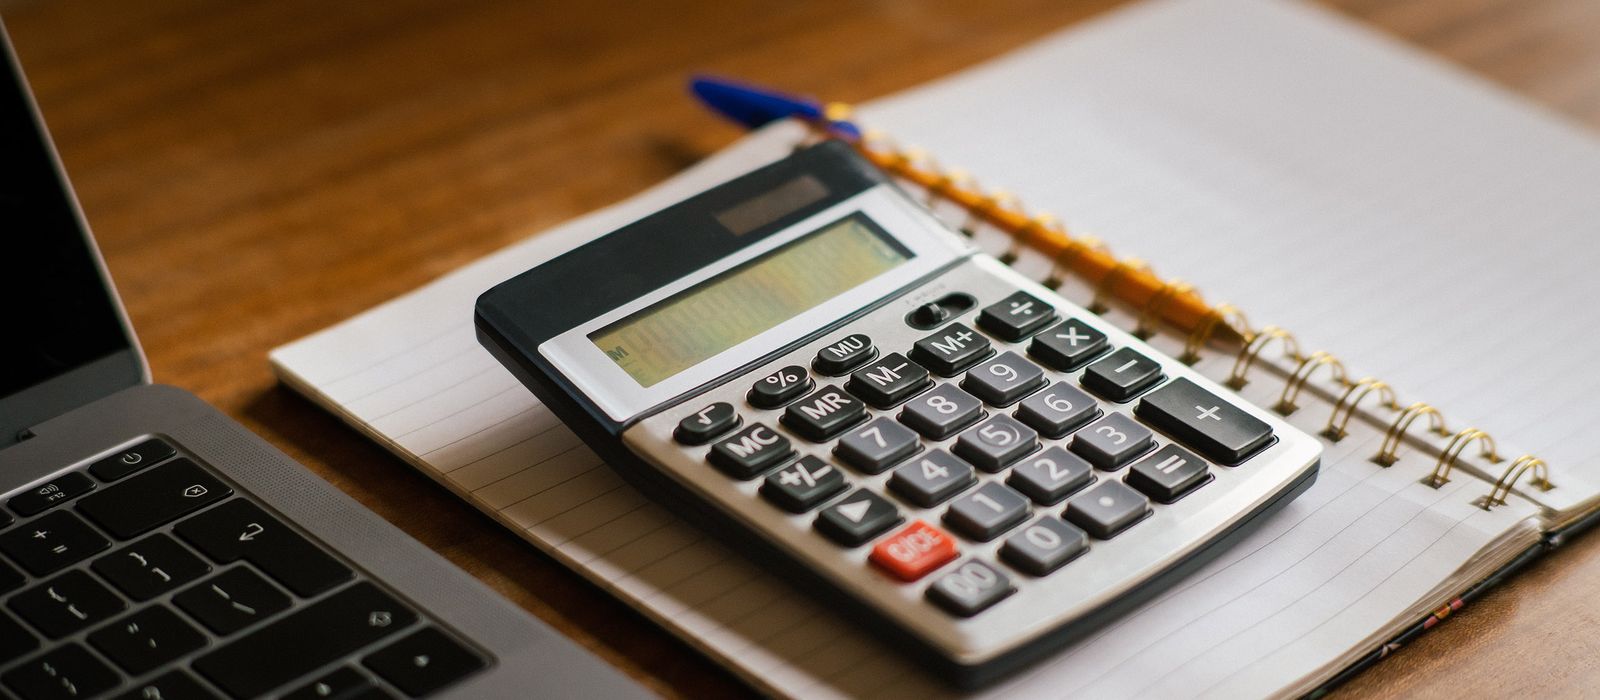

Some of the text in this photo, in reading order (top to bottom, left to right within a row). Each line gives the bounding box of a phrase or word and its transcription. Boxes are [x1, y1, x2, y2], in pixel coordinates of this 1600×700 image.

[608, 346, 630, 361] M
[828, 336, 864, 359] MU
[931, 330, 972, 356] M+
[766, 372, 798, 388] %
[989, 363, 1018, 382] 9
[801, 391, 851, 420] MR
[926, 395, 958, 414] 8
[1043, 393, 1073, 413] 6
[725, 426, 778, 458] MC
[860, 427, 887, 448] 7
[979, 424, 1013, 446] 5
[1095, 424, 1128, 446] 3
[920, 458, 949, 481] 4
[1033, 458, 1070, 481] 2
[972, 493, 1005, 513] 1
[1024, 525, 1062, 550] 0
